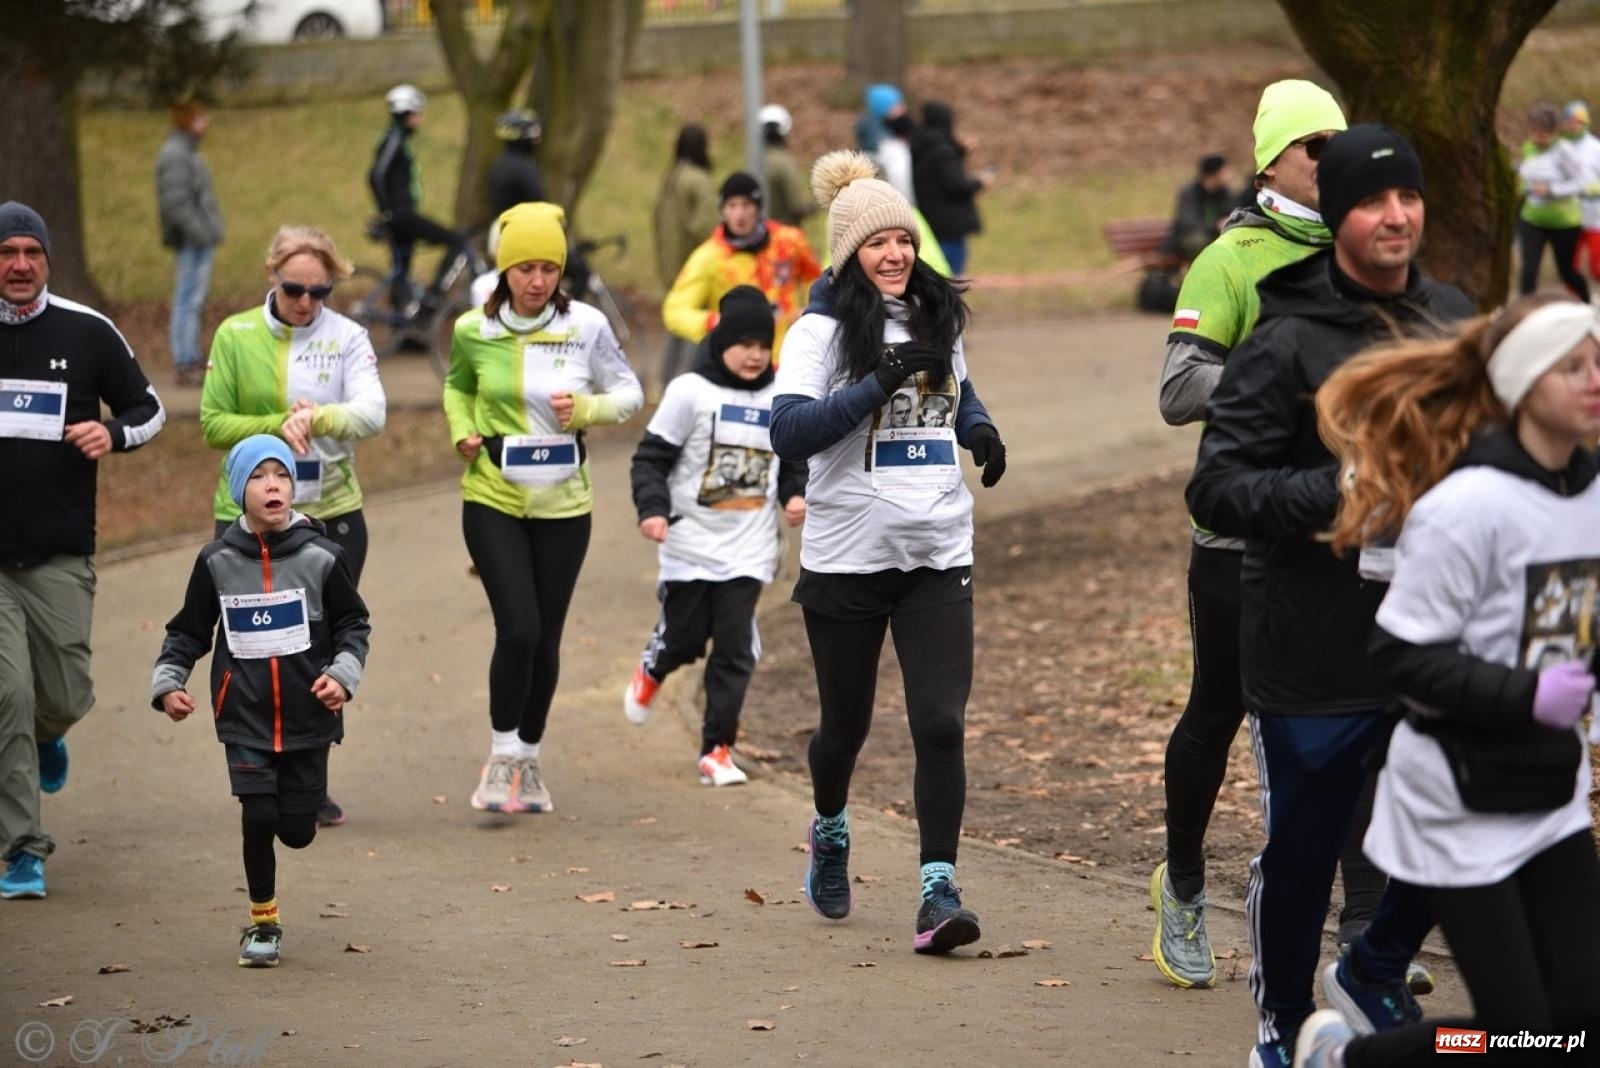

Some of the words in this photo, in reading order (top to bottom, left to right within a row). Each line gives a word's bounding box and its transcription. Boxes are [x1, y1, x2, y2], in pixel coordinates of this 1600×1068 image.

[13, 393, 33, 409] 67
[531, 447, 550, 462] 49
[907, 444, 927, 460] 84
[252, 610, 272, 626] 66
